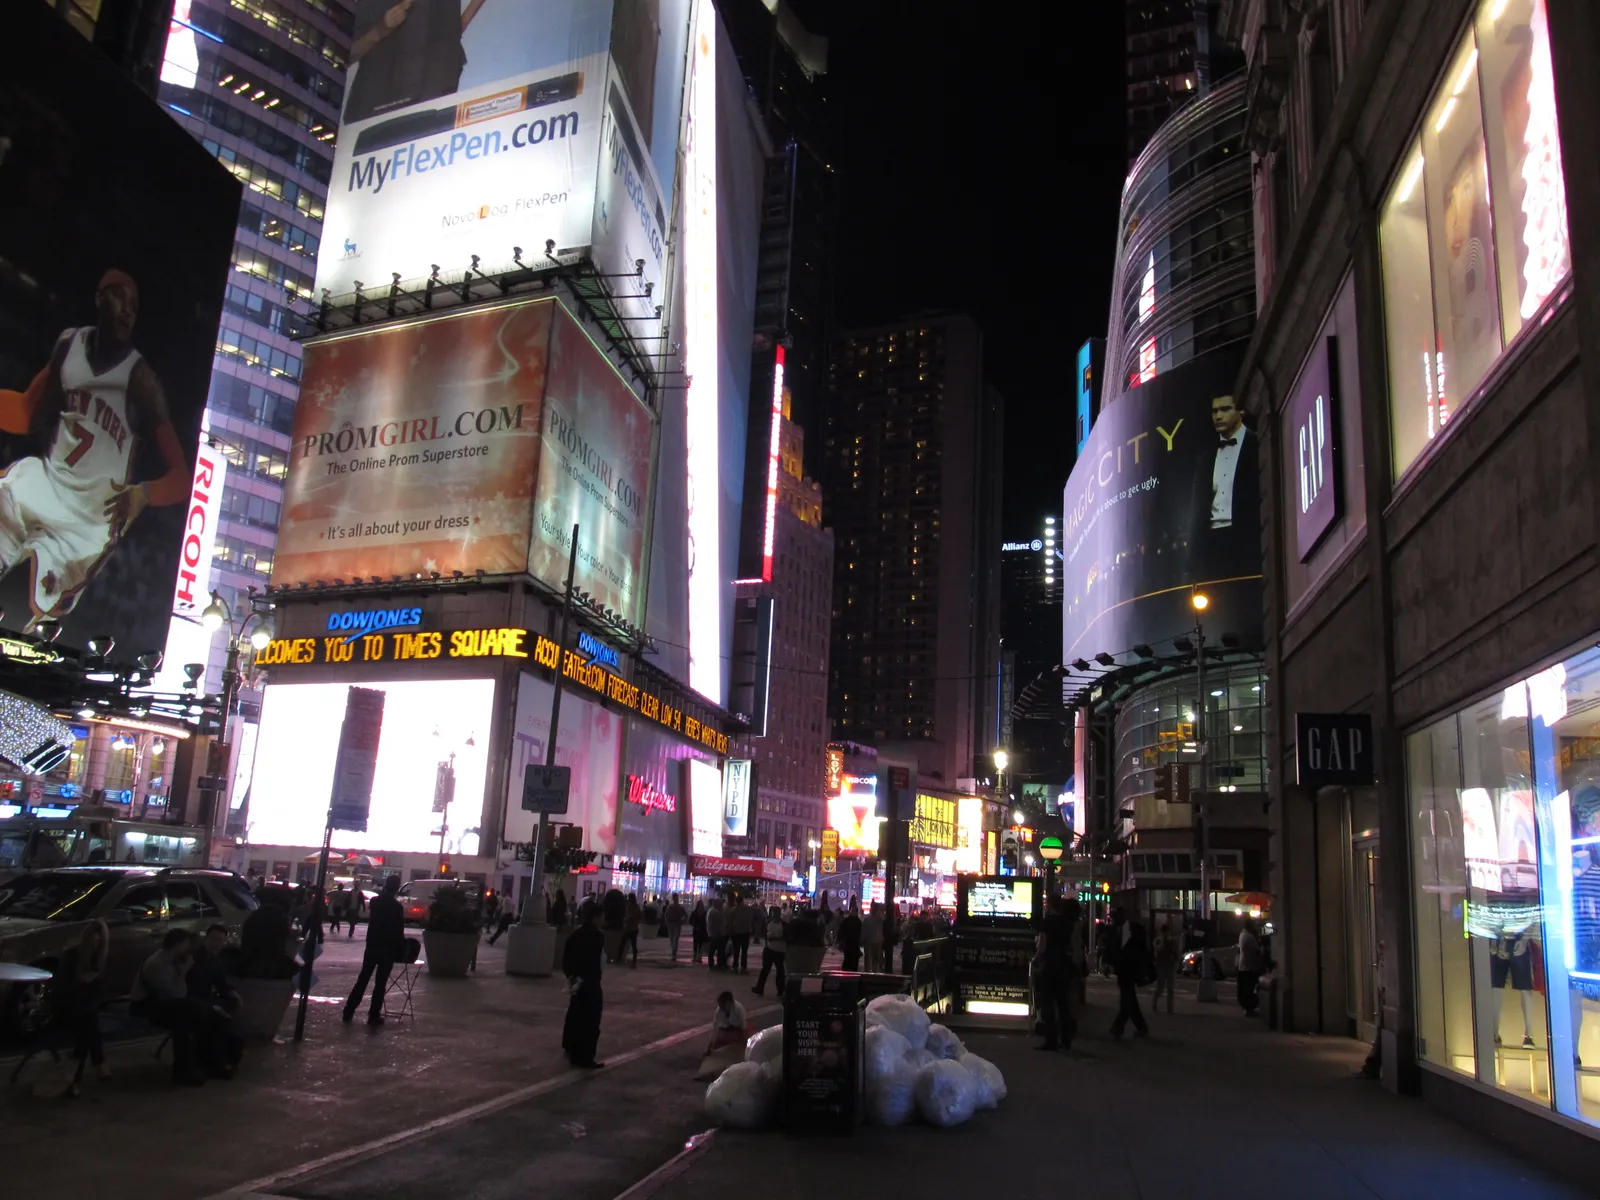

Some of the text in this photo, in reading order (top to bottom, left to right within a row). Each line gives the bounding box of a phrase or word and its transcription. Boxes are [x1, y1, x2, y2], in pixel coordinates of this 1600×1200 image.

[348, 110, 579, 194] MyFlexPen.com
[441, 204, 508, 229] NovoLog
[534, 255, 578, 270] SHEROOD
[94, 397, 127, 454] YORK
[64, 420, 95, 468] 7
[1098, 418, 1185, 488] CITY
[1299, 394, 1325, 515] GAP
[326, 445, 489, 476] The Online Prom Superstore
[1128, 484, 1140, 499] get
[1141, 475, 1160, 492] ugly.
[176, 456, 215, 603] RICOH
[327, 514, 469, 540] It's all about your dress
[556, 528, 571, 549] style
[1001, 541, 1029, 551] Allianz
[324, 637, 355, 662] YOU
[363, 635, 384, 661] TO
[392, 632, 442, 660] TIMES
[449, 628, 528, 658] SQUARE
[640, 692, 660, 721] CLEAR
[660, 703, 673, 727] LOW
[1307, 727, 1363, 771] GAP
[730, 764, 742, 817] NYPD
[693, 857, 755, 874] Walgreens
[795, 1020, 821, 1029] START
[797, 1029, 818, 1038] YOUR
[797, 1038, 818, 1047] VISIT
[797, 1048, 817, 1056] HERE
